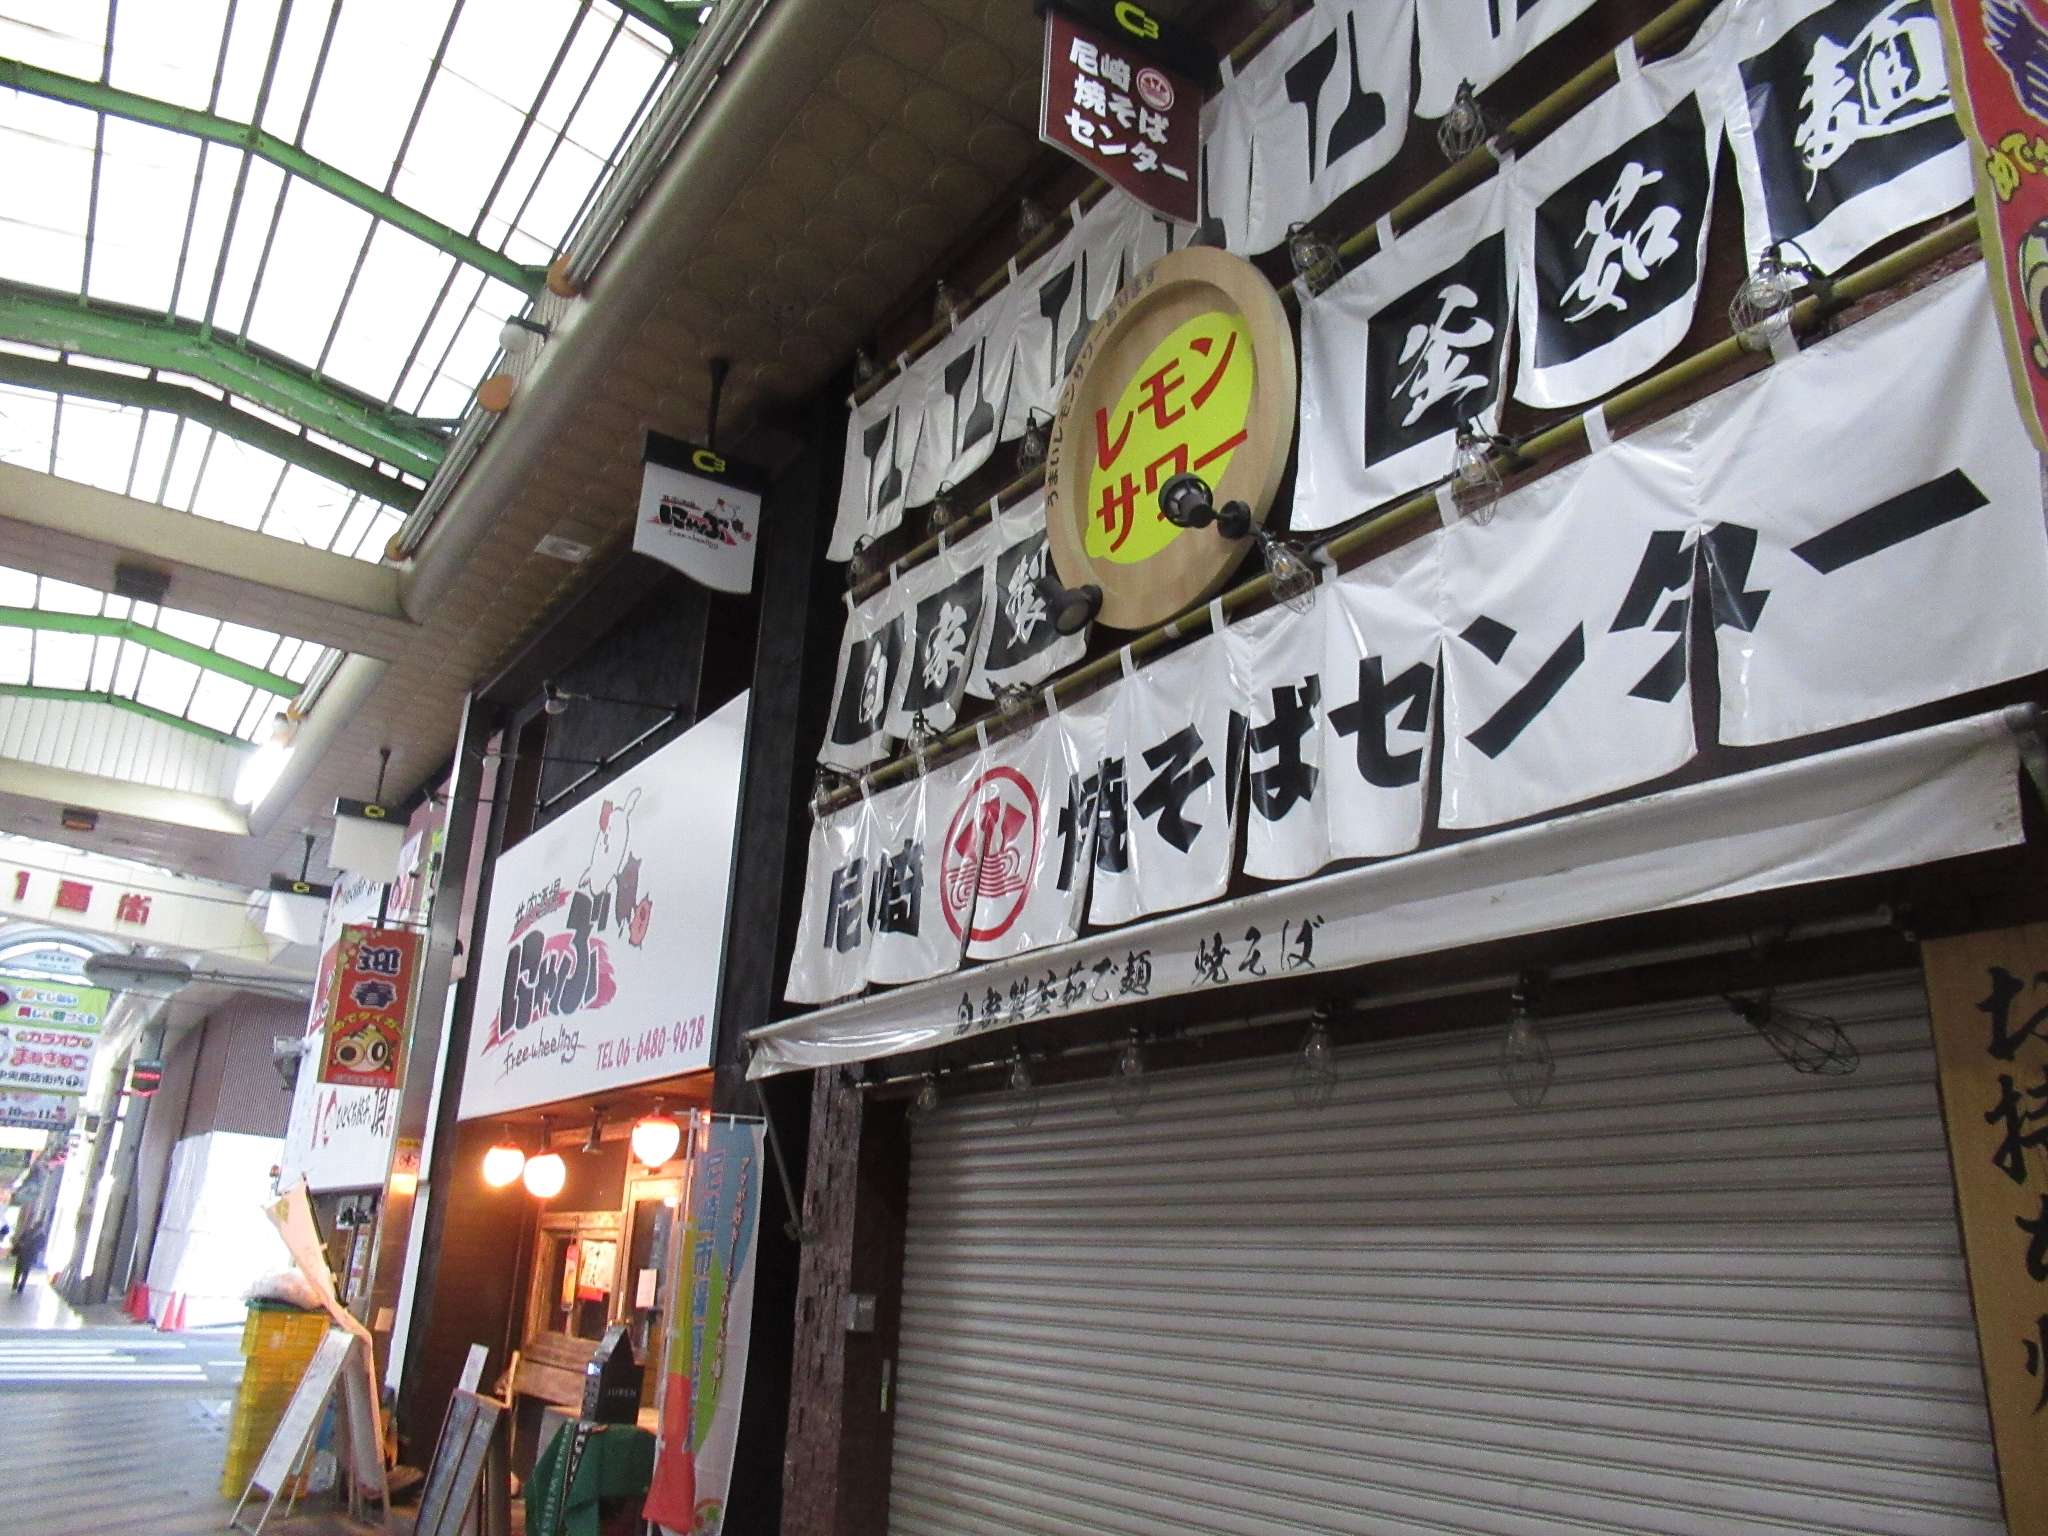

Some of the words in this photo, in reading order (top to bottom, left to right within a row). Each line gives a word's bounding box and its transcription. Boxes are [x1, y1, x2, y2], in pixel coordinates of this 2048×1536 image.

[1070, 37, 1131, 92] 尼崎
[1064, 108, 1189, 183] センター
[1072, 74, 1170, 145] 焼そば
[1095, 331, 1238, 471] レモン
[1095, 429, 1248, 552] サワー
[824, 838, 924, 954] 尼崎
[1191, 914, 1324, 986] 焼そば
[597, 1039, 614, 1070] TEL
[616, 1015, 706, 1068] 06-6480-9678
